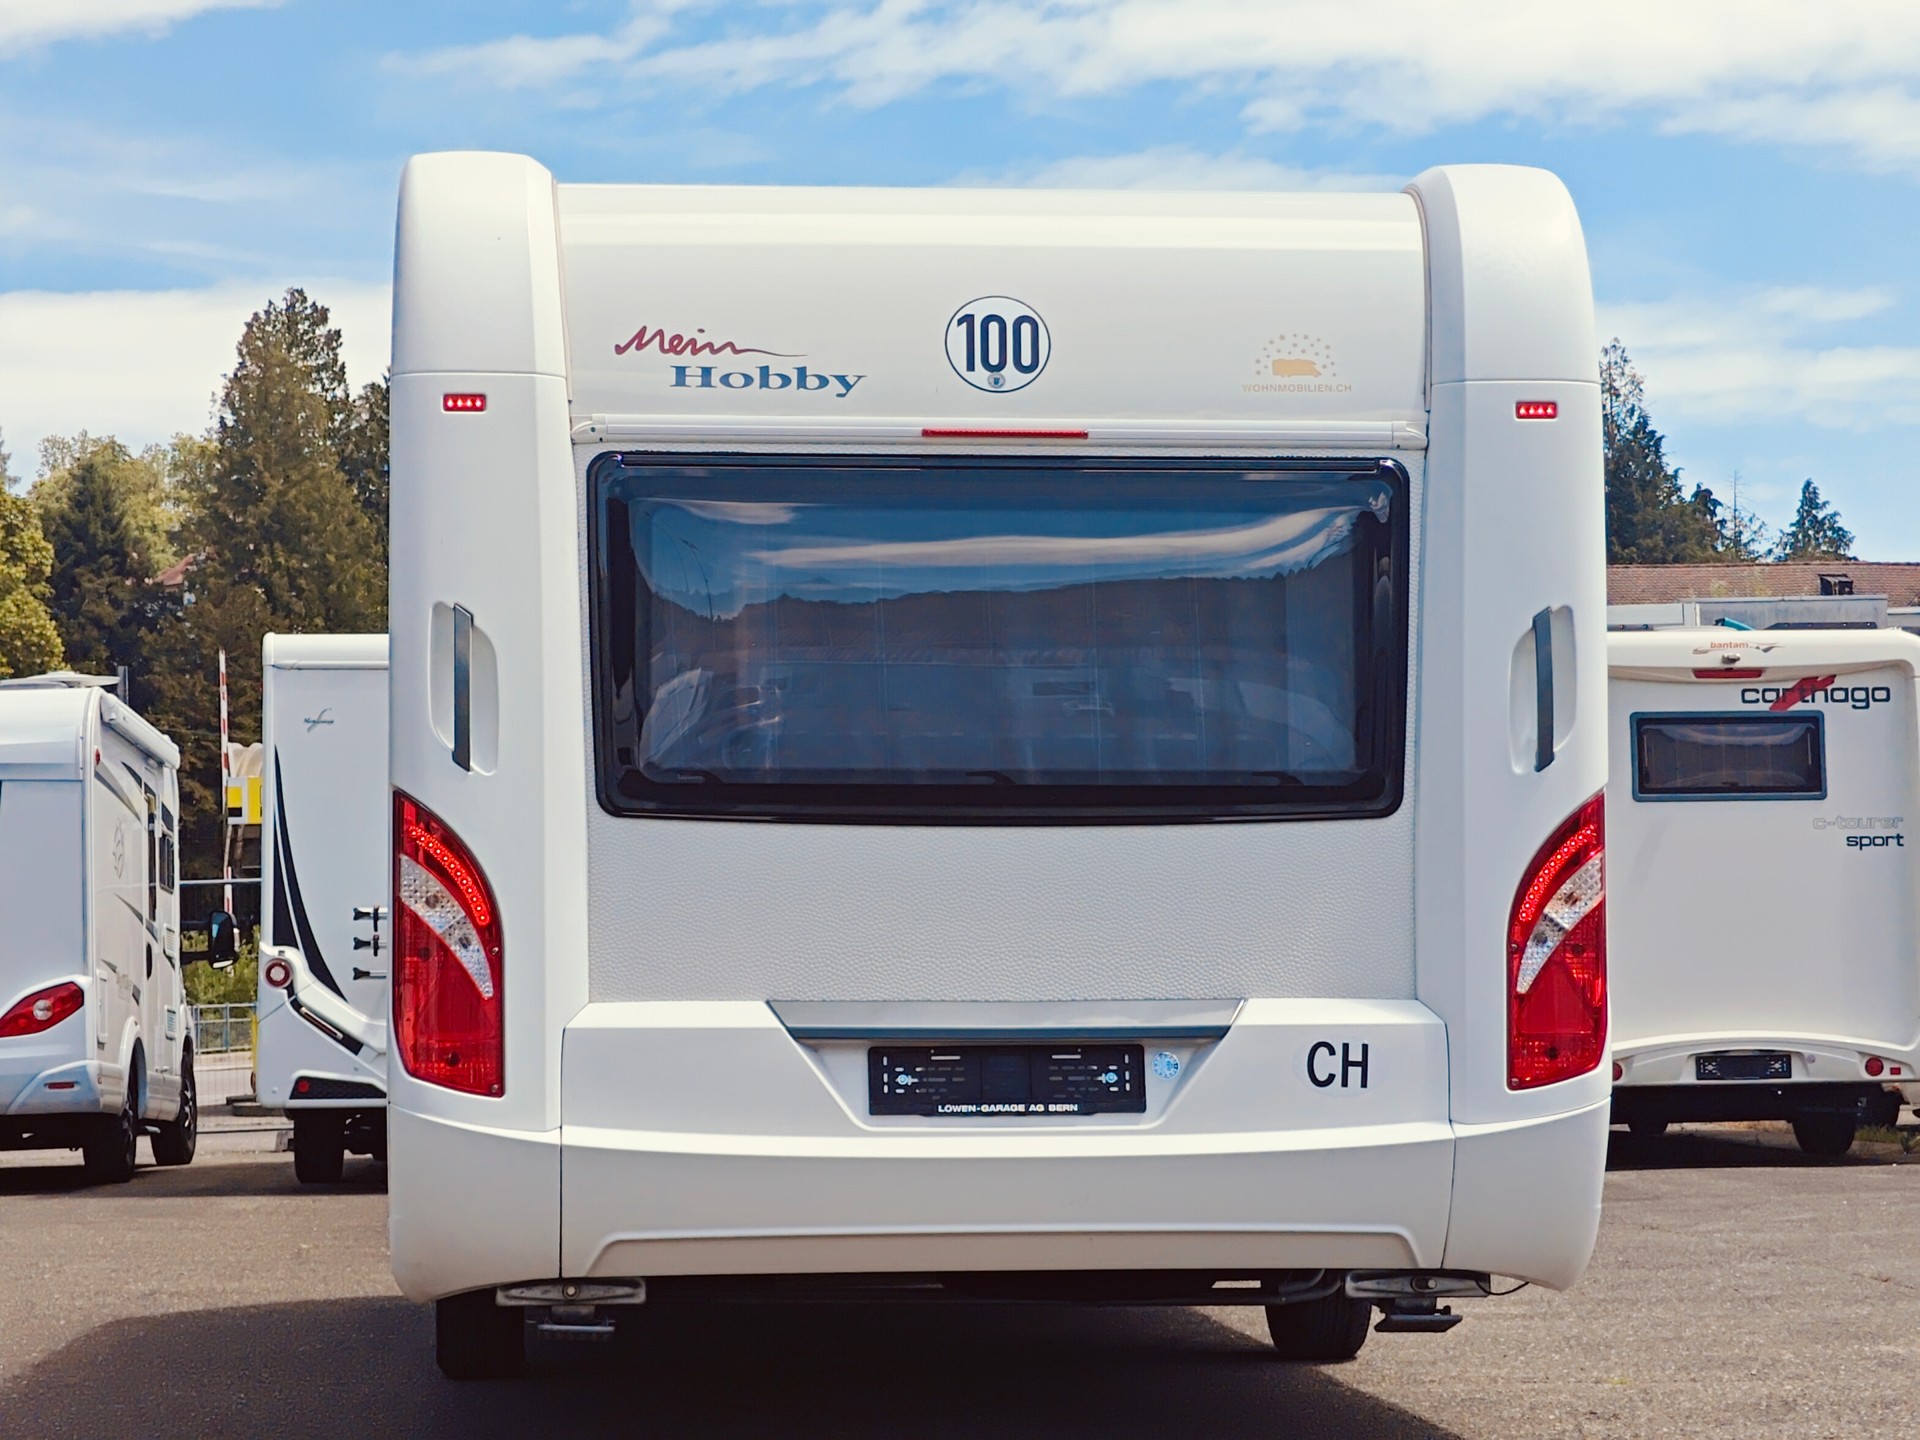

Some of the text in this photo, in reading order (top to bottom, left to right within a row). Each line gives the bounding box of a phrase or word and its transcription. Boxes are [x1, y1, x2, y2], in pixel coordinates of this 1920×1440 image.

[614, 325, 808, 357] Mein
[956, 313, 1040, 374] 100
[669, 365, 867, 398] Hobby
[1241, 383, 1353, 393] WOHNMOBILIEN.CH
[1710, 641, 1749, 649] bantam
[1812, 815, 1904, 830] c-tourer
[1846, 833, 1904, 851] sport
[1306, 1040, 1369, 1089] CH
[1028, 1104, 1045, 1112] AG
[1048, 1104, 1079, 1112] BERN
